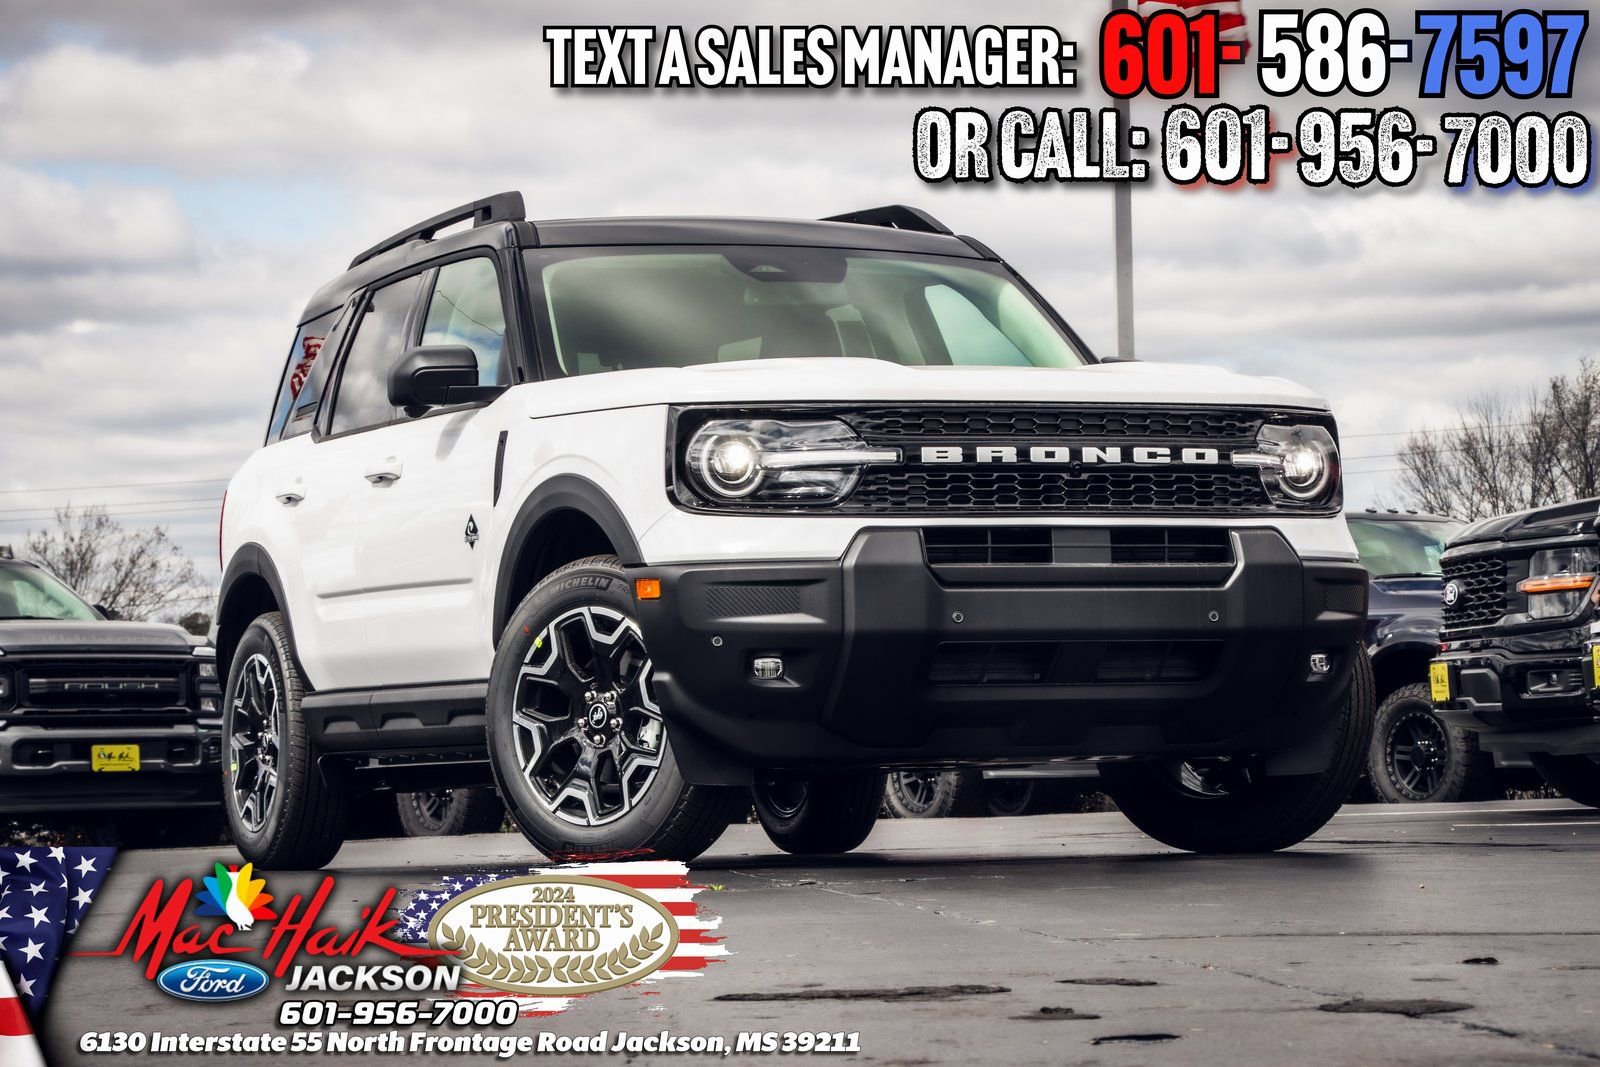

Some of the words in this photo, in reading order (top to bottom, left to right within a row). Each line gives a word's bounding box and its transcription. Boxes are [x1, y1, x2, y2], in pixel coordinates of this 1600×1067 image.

[921, 446, 1219, 464] BRONCO
[550, 576, 610, 594] MICHELIN
[64, 682, 159, 690] ROUSH
